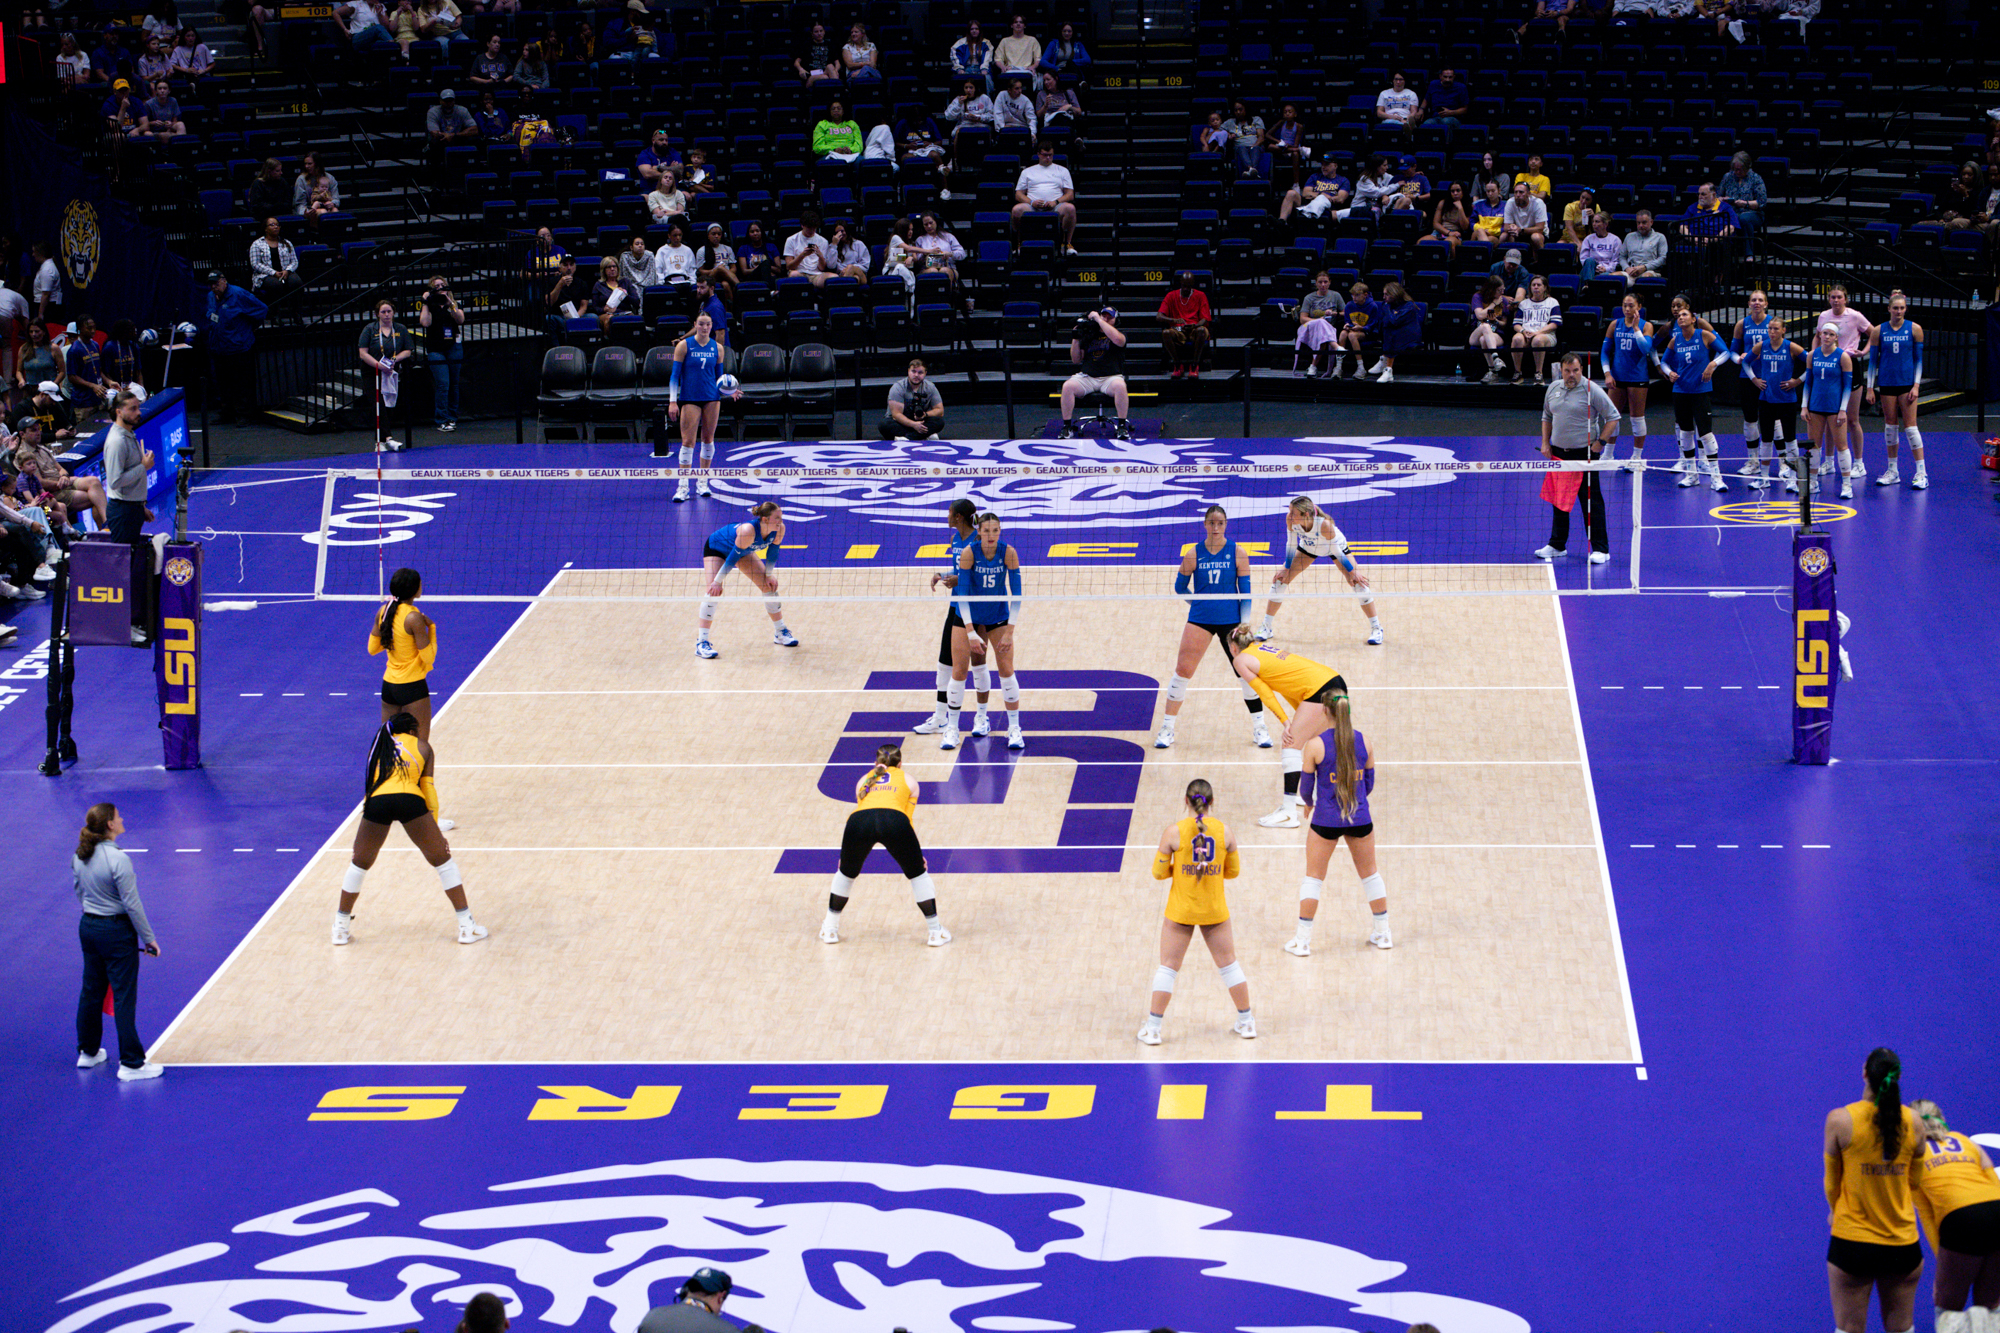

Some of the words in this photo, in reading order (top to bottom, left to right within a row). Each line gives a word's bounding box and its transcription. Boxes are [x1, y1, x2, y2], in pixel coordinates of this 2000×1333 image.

[481, 63, 505, 73] LSU
[1104, 77, 1122, 87] 108
[1164, 76, 1183, 86] 109
[1982, 80, 2000, 89] 109
[291, 103, 308, 113] 108
[1591, 243, 1613, 251] LSU
[669, 254, 685, 264] LSU
[1078, 271, 1098, 282] 108
[1144, 271, 1163, 281] 109
[1621, 339, 1633, 350] 20
[1677, 345, 1700, 353] KENTUCKY
[1892, 342, 1900, 354] 8
[1685, 352, 1692, 363] 2
[700, 358, 707, 369] 7
[1770, 361, 1778, 372] 11
[1813, 360, 1837, 368] KENTUCKY
[1821, 368, 1826, 379] 1
[411, 470, 443, 478] GEAUX
[446, 470, 481, 478] TIGERS
[588, 469, 621, 477] GEAUX
[623, 469, 659, 477] TIGERS
[767, 468, 799, 476] GEAUX
[802, 468, 838, 476] TIGERS
[856, 468, 889, 476] GEAUX
[891, 468, 928, 476] TIGERS
[946, 467, 979, 475] GEAUX
[981, 467, 1017, 475] TIGERS
[1036, 466, 1069, 474] GEAUX
[1071, 466, 1108, 474] TIGERS
[1126, 465, 1159, 474] GEAUX
[1162, 465, 1198, 474] TIGERS
[1216, 465, 1250, 473] GEAUX
[1252, 465, 1289, 473] TIGERS
[1307, 463, 1340, 472] GEAUX
[1343, 463, 1379, 472] TIGERS
[1398, 462, 1431, 471] GEAUX
[1434, 462, 1470, 471] TIGERS
[1489, 461, 1522, 470] GEAUX
[1525, 461, 1562, 470] TIGERS
[975, 565, 1004, 575] KENTUCKY
[1198, 561, 1231, 570] KENTUCKY
[982, 574, 996, 588] 15
[1208, 569, 1221, 585] 17
[77, 585, 124, 603] LSU
[1796, 609, 1830, 708] LSU
[164, 617, 196, 715] LSU
[1925, 1136, 1963, 1156] 13
